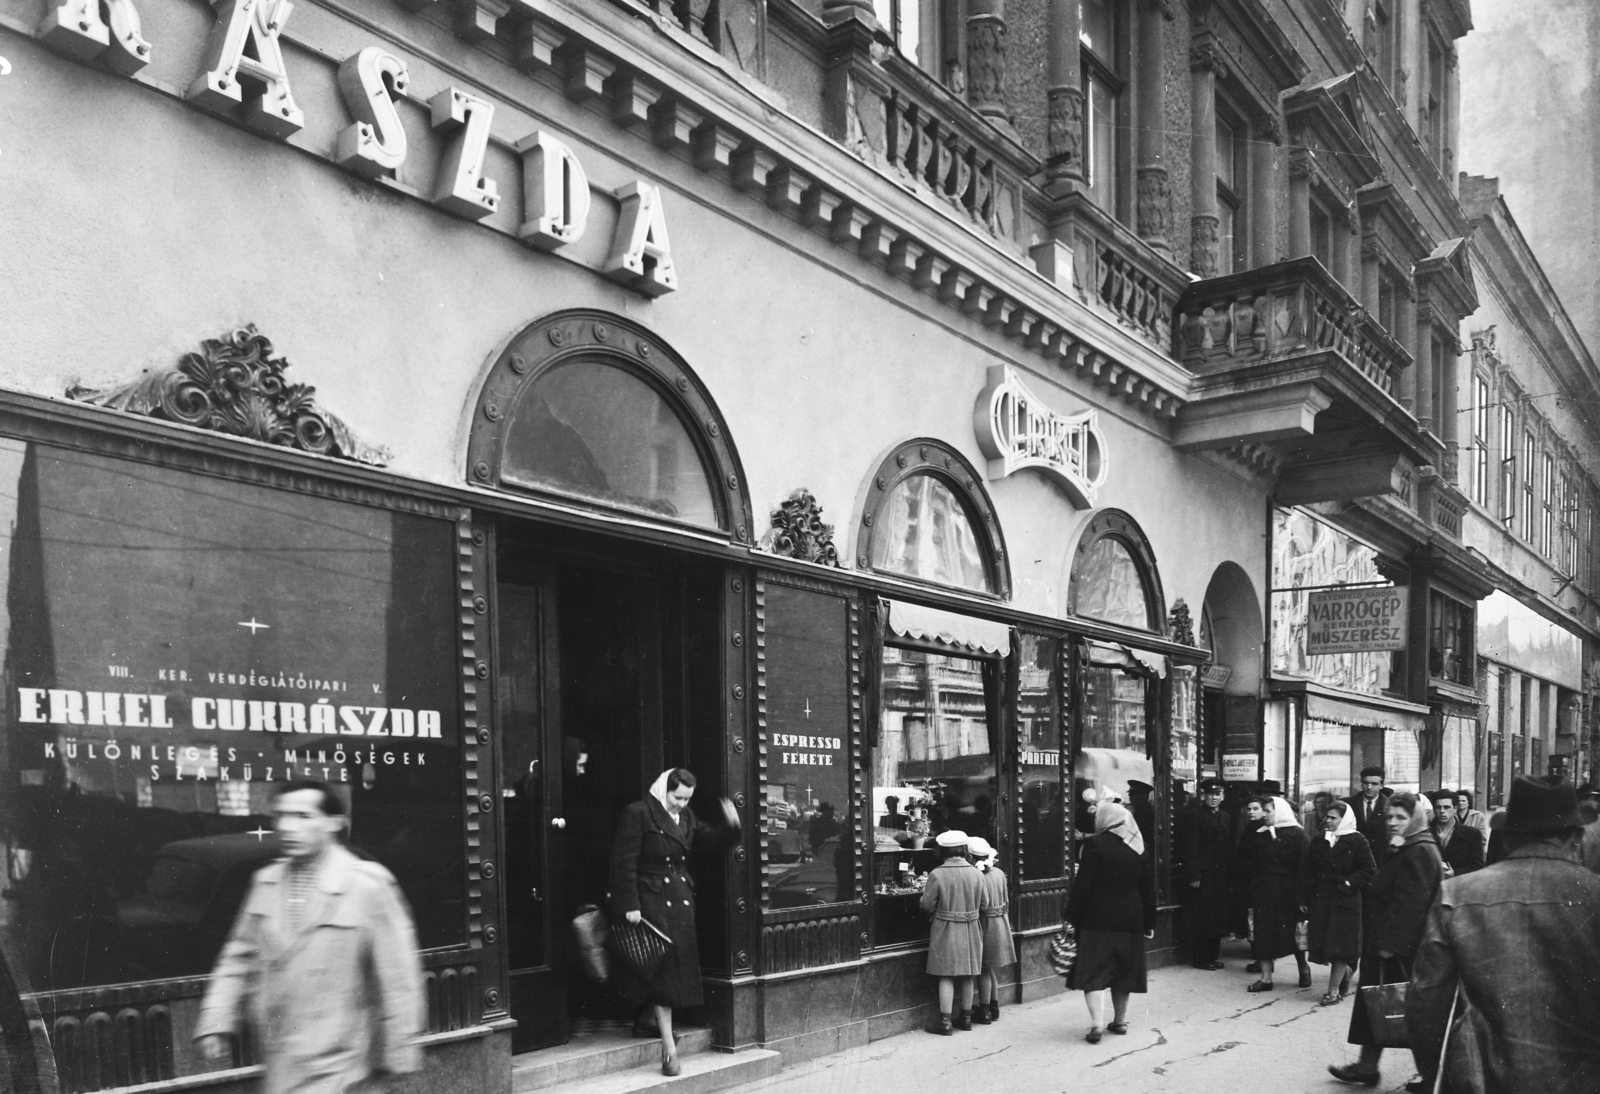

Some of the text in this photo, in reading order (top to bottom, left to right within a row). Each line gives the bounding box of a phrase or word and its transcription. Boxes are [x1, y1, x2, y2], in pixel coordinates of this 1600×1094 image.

[1365, 589, 1398, 599] NÁNDOR
[1312, 597, 1402, 622] VARRÓGÉP
[1323, 617, 1391, 630] KERÉKPÁR
[109, 665, 382, 694] VIII. KER. VENDÉGLÁTÓIPARI V.
[18, 687, 443, 739] ERKEL CUKRÁSZDA
[44, 737, 237, 762] KÜLÖNLEGES
[773, 733, 841, 750] ESPRESSO
[782, 752, 834, 766] FEKETE
[1021, 751, 1060, 766] PARFAIT
